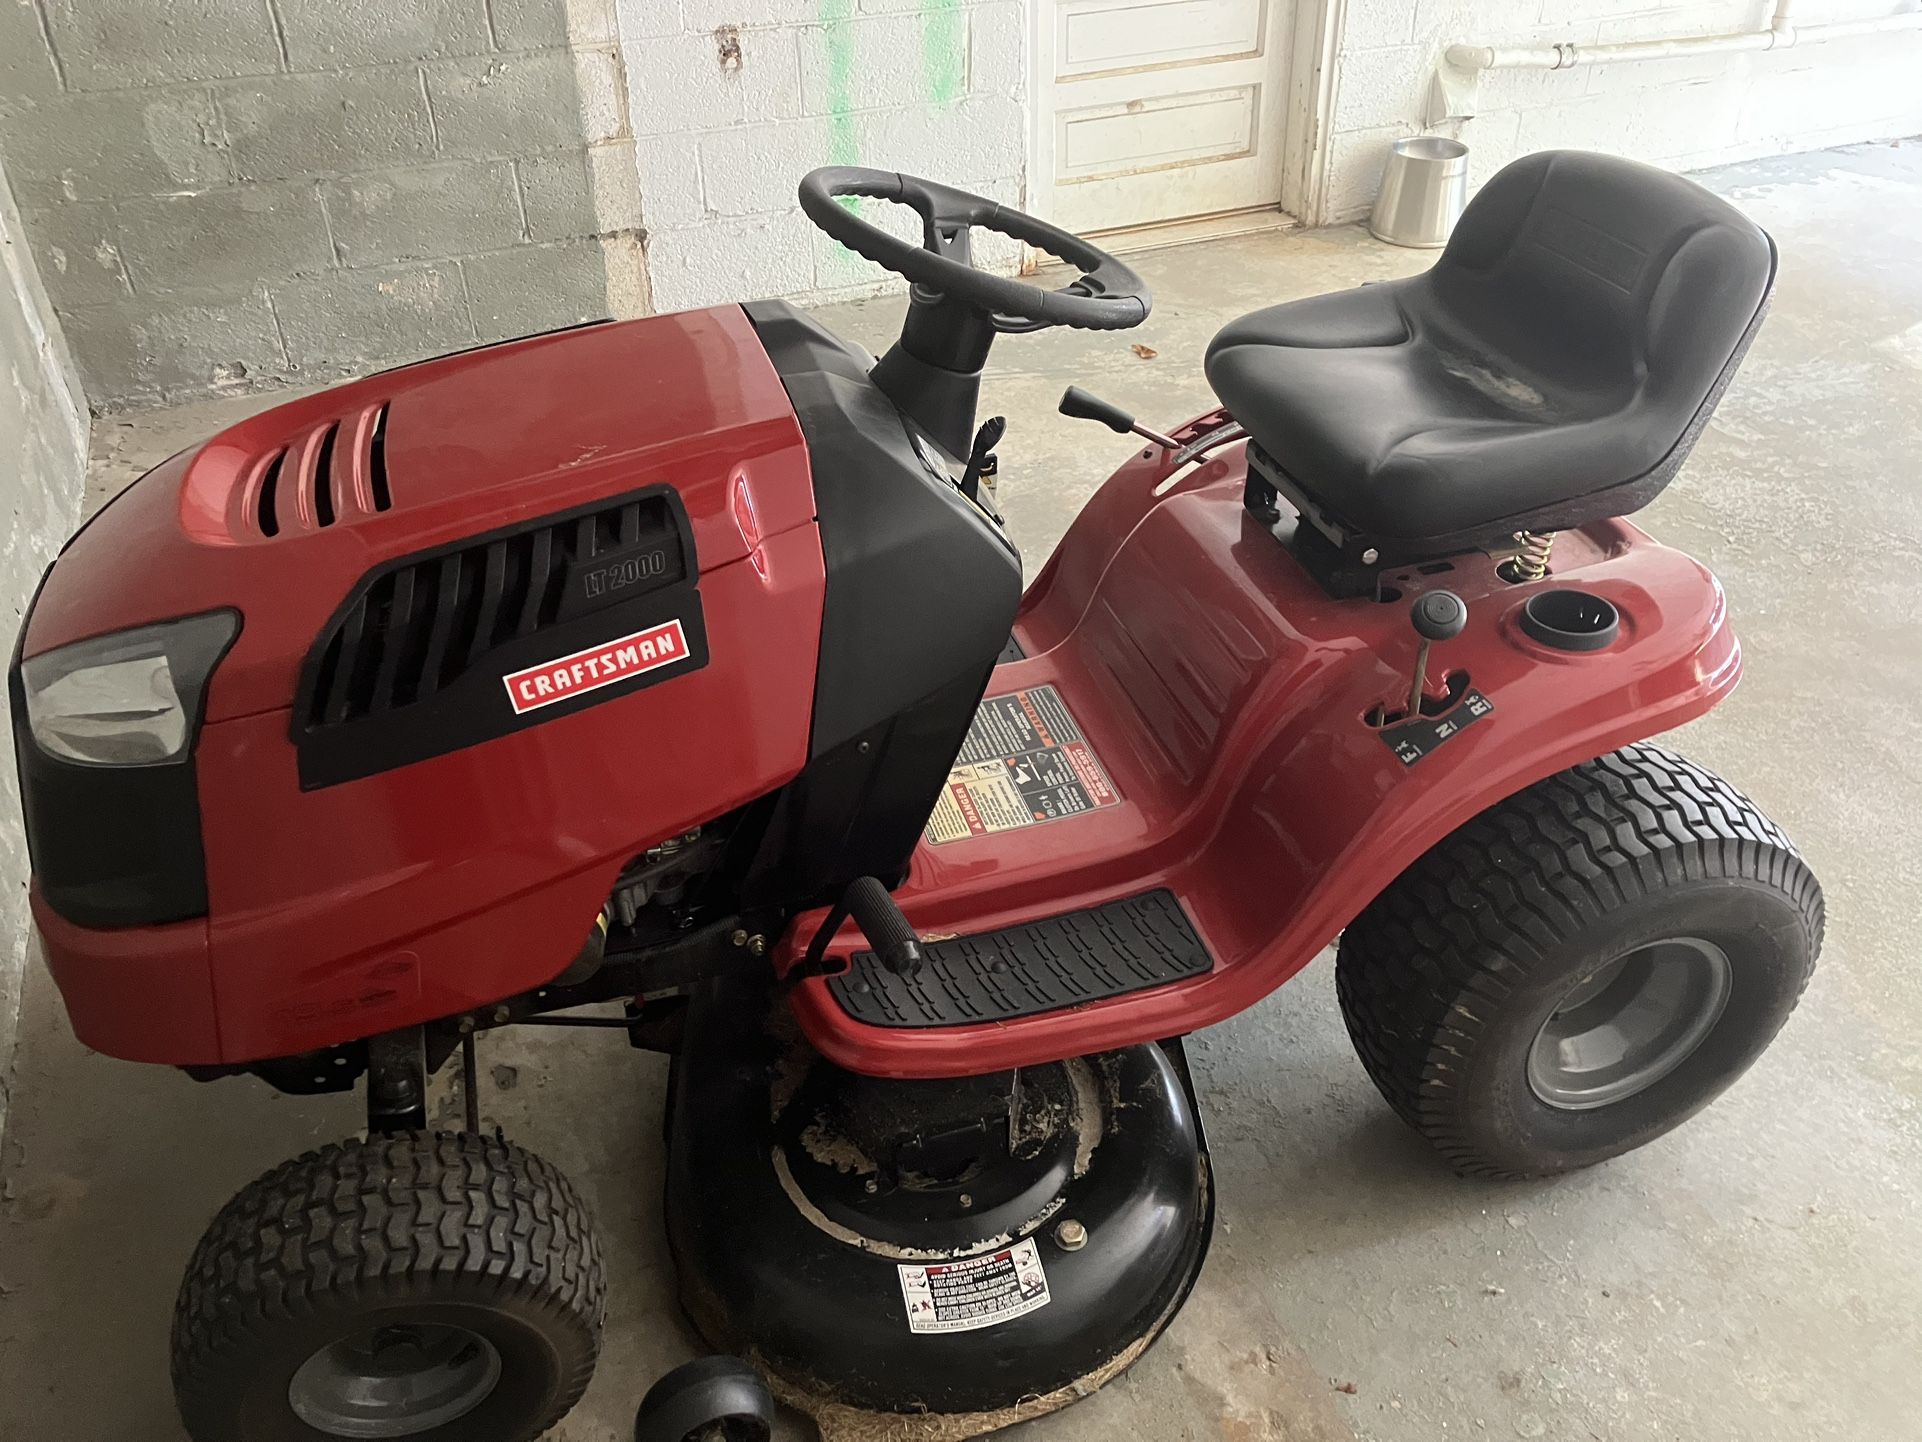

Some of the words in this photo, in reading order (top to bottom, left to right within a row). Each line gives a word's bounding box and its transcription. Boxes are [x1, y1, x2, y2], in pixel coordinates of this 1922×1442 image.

[584, 570, 606, 598] LT
[609, 551, 666, 589] 2000
[518, 632, 675, 701] CRAFTSMAN
[1020, 696, 1045, 733] WARNING
[1470, 701, 1488, 716] R
[1435, 723, 1454, 738] N
[1401, 751, 1417, 764] F
[955, 788, 977, 821] DANGER
[951, 1257, 995, 1271] DANGER
